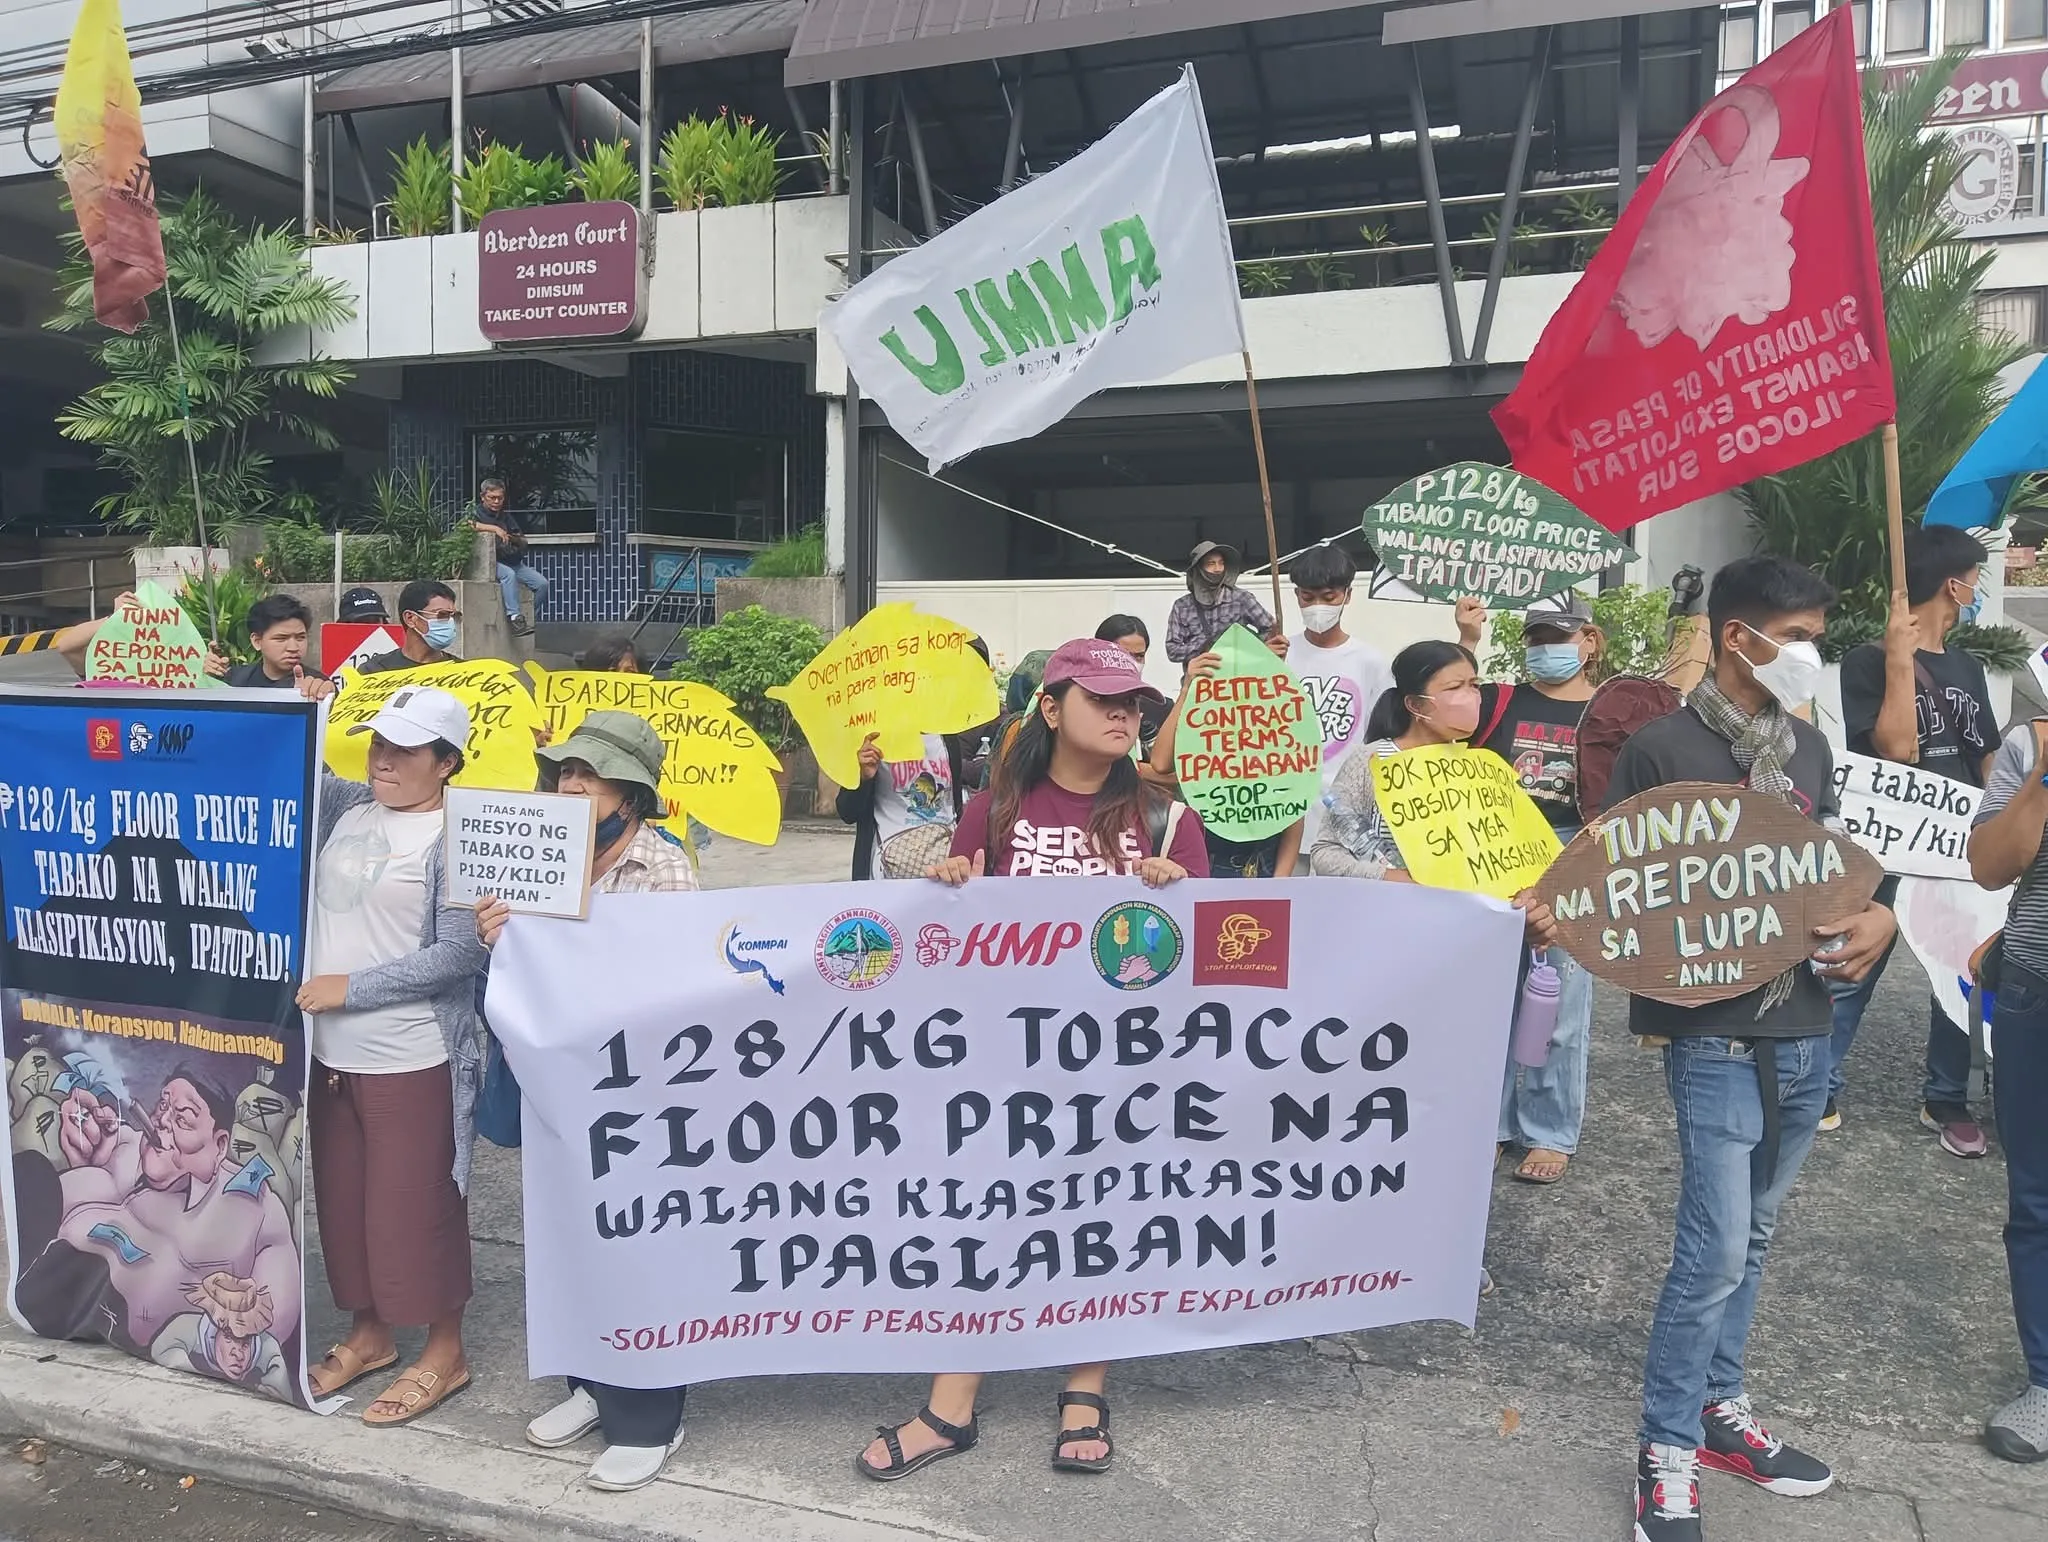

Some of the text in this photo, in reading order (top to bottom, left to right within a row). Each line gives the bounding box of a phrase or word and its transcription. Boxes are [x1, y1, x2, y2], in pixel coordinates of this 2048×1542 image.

[485, 217, 628, 253] Aberdeen Court
[516, 259, 597, 279] 24 HOURS
[527, 283, 584, 299] DIMSUM
[485, 301, 628, 322] TAKE-OUT COUNTER
[1373, 503, 1602, 550] TABAKO FLOOR PRICE
[1376, 528, 1623, 576] WALANG KLASIPIKASYON
[1396, 553, 1546, 599] IPATUPAD!
[122, 606, 180, 626] TUNAY
[93, 640, 201, 661] REPORMA
[134, 627, 161, 642] NA
[896, 636, 920, 657] sa
[96, 659, 197, 680] SA LUPA,
[545, 675, 689, 710] ISARDENG
[826, 690, 842, 708] na
[846, 676, 876, 705] para
[1194, 674, 1299, 704] BETTER
[545, 705, 567, 731] TI
[1186, 696, 1305, 729] CONTRACT
[1200, 725, 1301, 753] TERMS,
[1177, 745, 1319, 782] IPAGLABAN!
[1380, 757, 1424, 793] 30K
[1871, 762, 1971, 817] tabako
[110, 789, 181, 840] FLOOR
[194, 793, 260, 846] PRICE
[269, 798, 297, 849] NG
[461, 817, 568, 840] PRESYO NG
[482, 804, 546, 818] ITAAS ANG
[1200, 799, 1308, 824] EXPLOITATION
[1425, 812, 1510, 857] SA MGA
[1601, 797, 1741, 865] TUNAY
[459, 839, 567, 863] TABAKO SA
[34, 849, 258, 914] TABAKO NA WALANG
[459, 862, 566, 886] P128/KILO!
[1055, 863, 1080, 876] the
[1554, 839, 1848, 921] NA REPORMA
[14, 906, 292, 985] KLASIPIKASYON, IPATUPAD!
[737, 938, 788, 952] KOMMPAI
[954, 921, 1083, 968] KMP
[1600, 903, 1784, 962] SA LUPA
[1204, 963, 1278, 973] STOP EXPLOITATION
[82, 1008, 177, 1046] Korapsyon,
[592, 1001, 1409, 1091] 128/KG TOBACCO
[588, 1081, 1409, 1181] FLOOR PRICE NA
[595, 1158, 1406, 1240] WALANG KLASIPIKASYON
[729, 1208, 1278, 1293] IPAGLABAN!
[811, 1309, 854, 1333] OF
[863, 1308, 1026, 1334] PEASANTS
[1035, 1290, 1169, 1326] AGAINST
